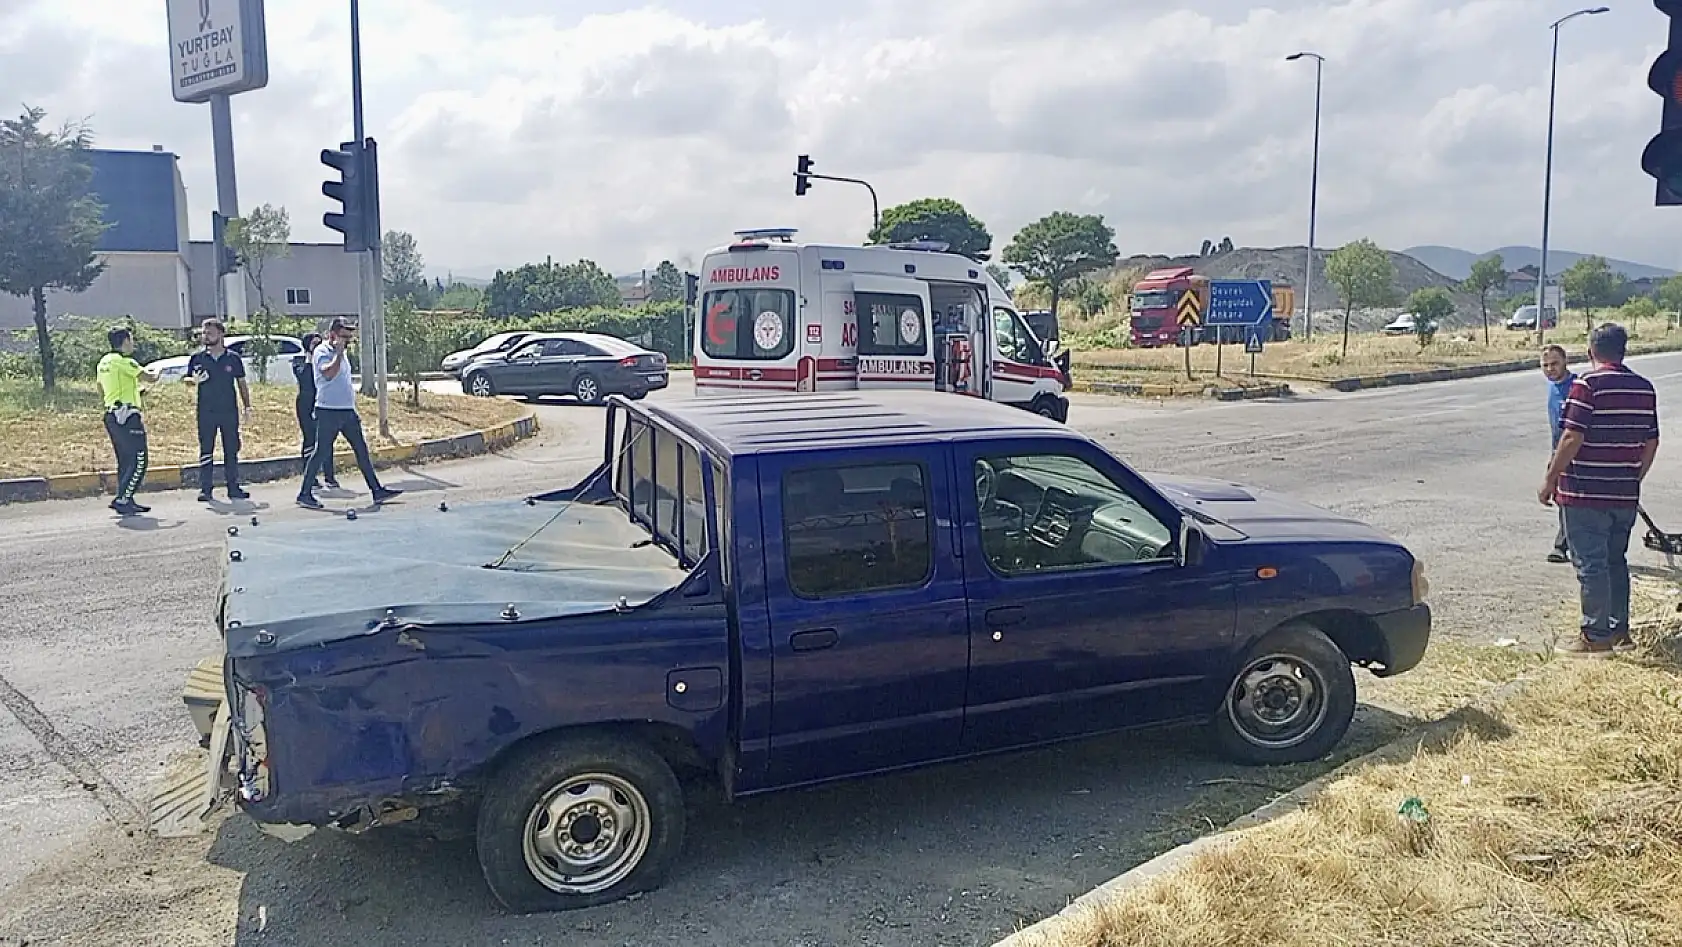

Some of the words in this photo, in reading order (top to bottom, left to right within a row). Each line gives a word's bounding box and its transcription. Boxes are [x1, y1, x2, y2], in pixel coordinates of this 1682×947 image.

[178, 25, 234, 58] YURTBAY
[181, 48, 233, 75] TUĞLA
[709, 265, 780, 283] AMBULANS
[1211, 310, 1243, 320] Ankara
[861, 360, 921, 375] AMBULANS
